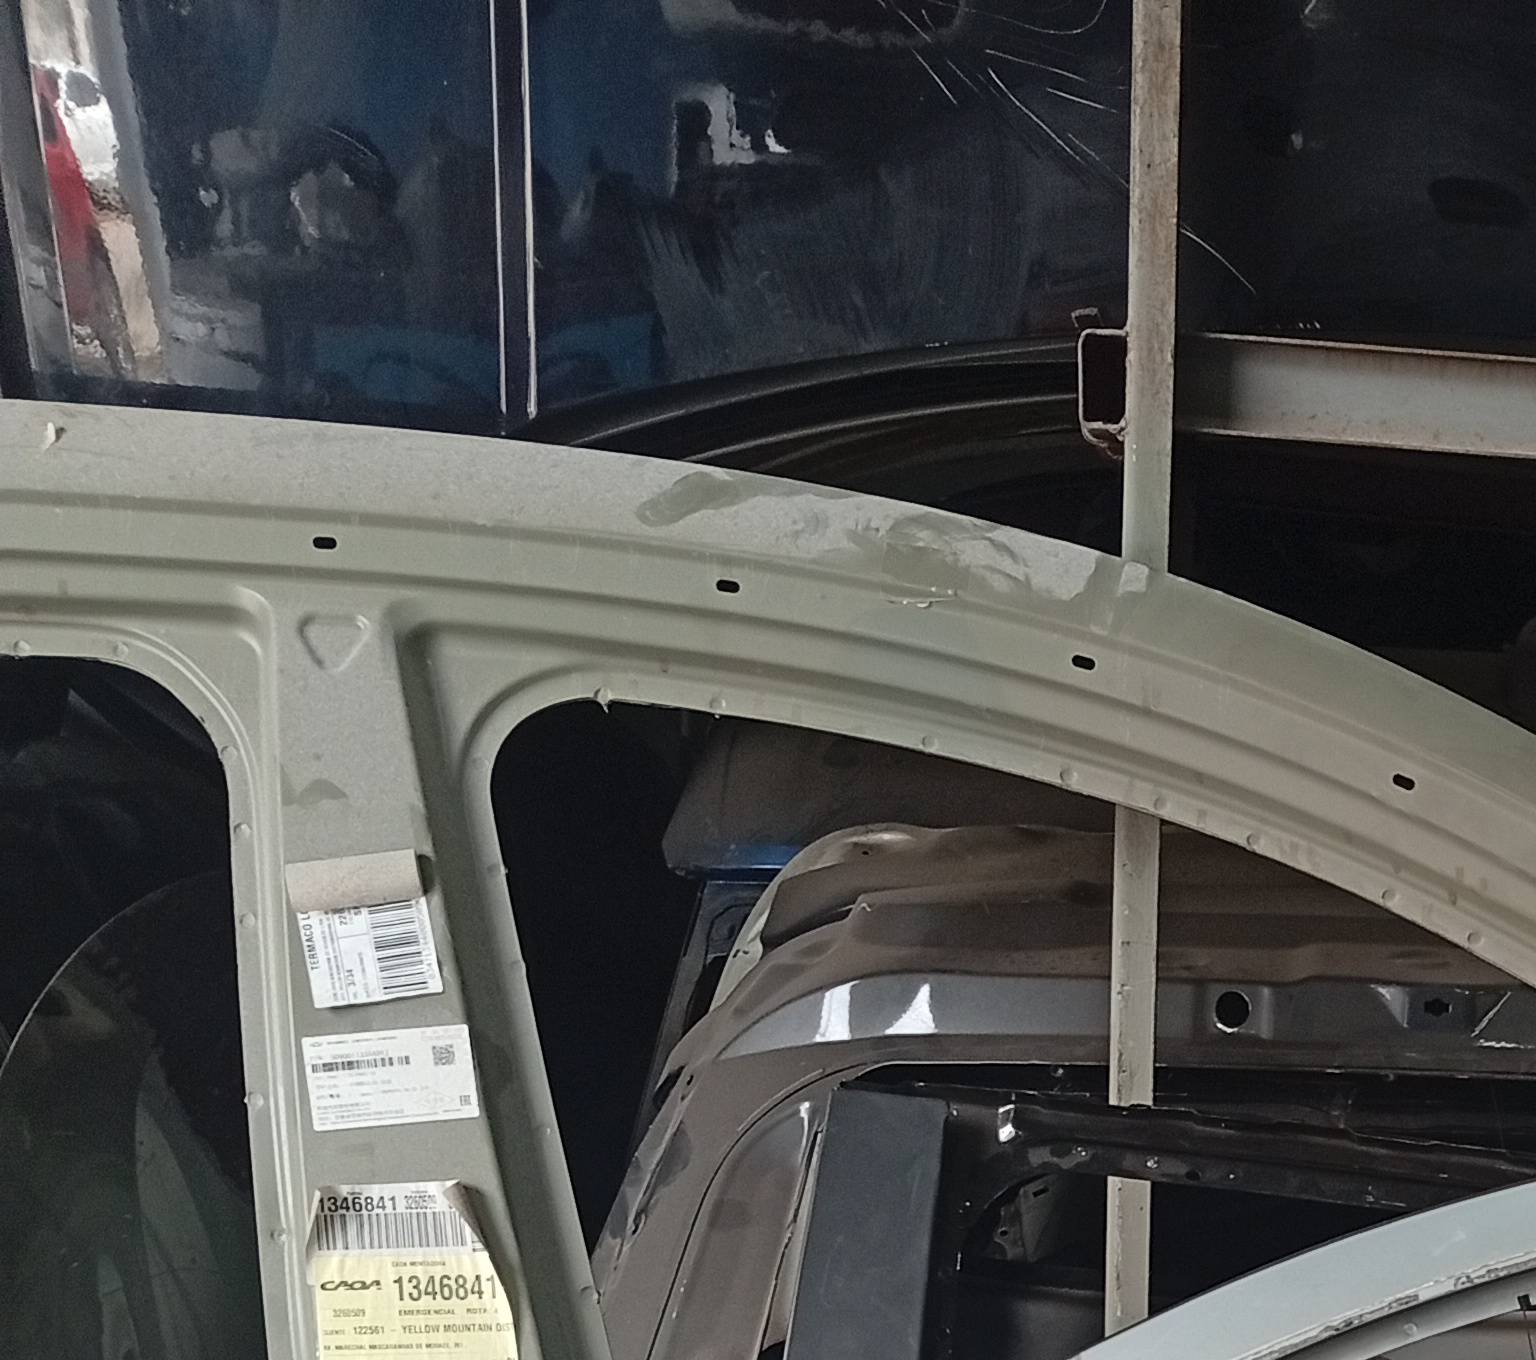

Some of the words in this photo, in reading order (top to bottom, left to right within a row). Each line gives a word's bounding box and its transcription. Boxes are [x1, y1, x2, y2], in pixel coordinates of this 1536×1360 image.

[303, 923, 320, 970] TERMACO
[318, 1195, 397, 1213] 1346841
[393, 1274, 497, 1302] 1346841
[353, 1326, 385, 1335] 122561
[402, 1324, 440, 1334] YELLOW
[443, 1323, 492, 1333] MOUNTAIN
